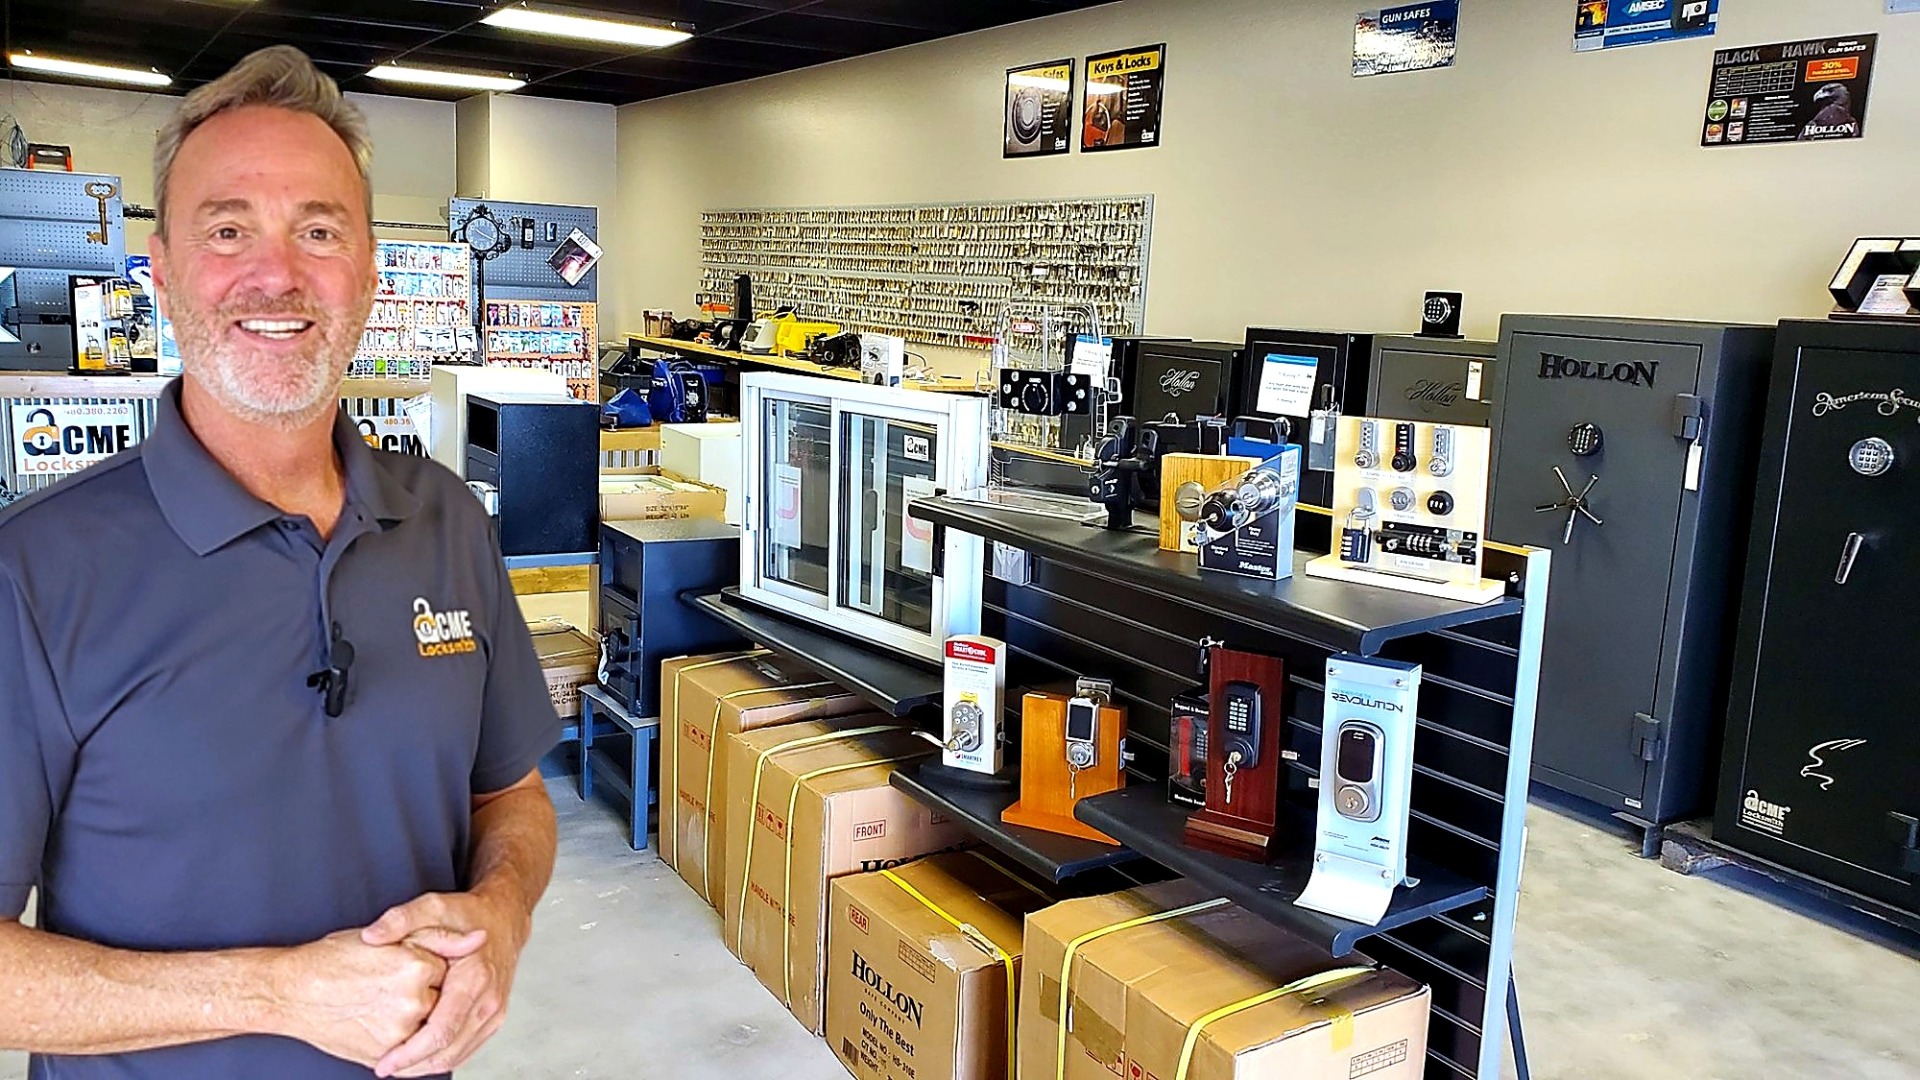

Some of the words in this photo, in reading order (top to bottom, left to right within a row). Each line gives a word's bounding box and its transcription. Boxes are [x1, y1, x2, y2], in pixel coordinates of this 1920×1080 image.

[1382, 14, 1402, 24] GUN
[1403, 8, 1431, 21] SAFES
[1627, 0, 1666, 14] AMSEC
[1715, 50, 1760, 65] BLACK
[1782, 42, 1825, 58] HAWK
[1094, 62, 1114, 75] Keys
[1115, 60, 1123, 71] &
[1125, 55, 1151, 69] Locks
[1822, 61, 1842, 70] 30%
[1804, 122, 1856, 136] HOLLON
[1538, 352, 1660, 390] HOLLON
[1159, 368, 1200, 397] Hollon
[1404, 379, 1462, 412] Hollon
[1812, 391, 1889, 417] American
[1238, 561, 1272, 573] Master
[1331, 691, 1403, 713] REVOLUTION
[1742, 808, 1784, 828] Locksmith
[855, 823, 884, 838] FRONT
[850, 908, 867, 931] REAR
[851, 948, 924, 1031] HOLLON
[859, 1000, 879, 1028] Only
[878, 1015, 895, 1041] The
[895, 1031, 915, 1057] Best
[862, 1026, 879, 1049] MODEL
